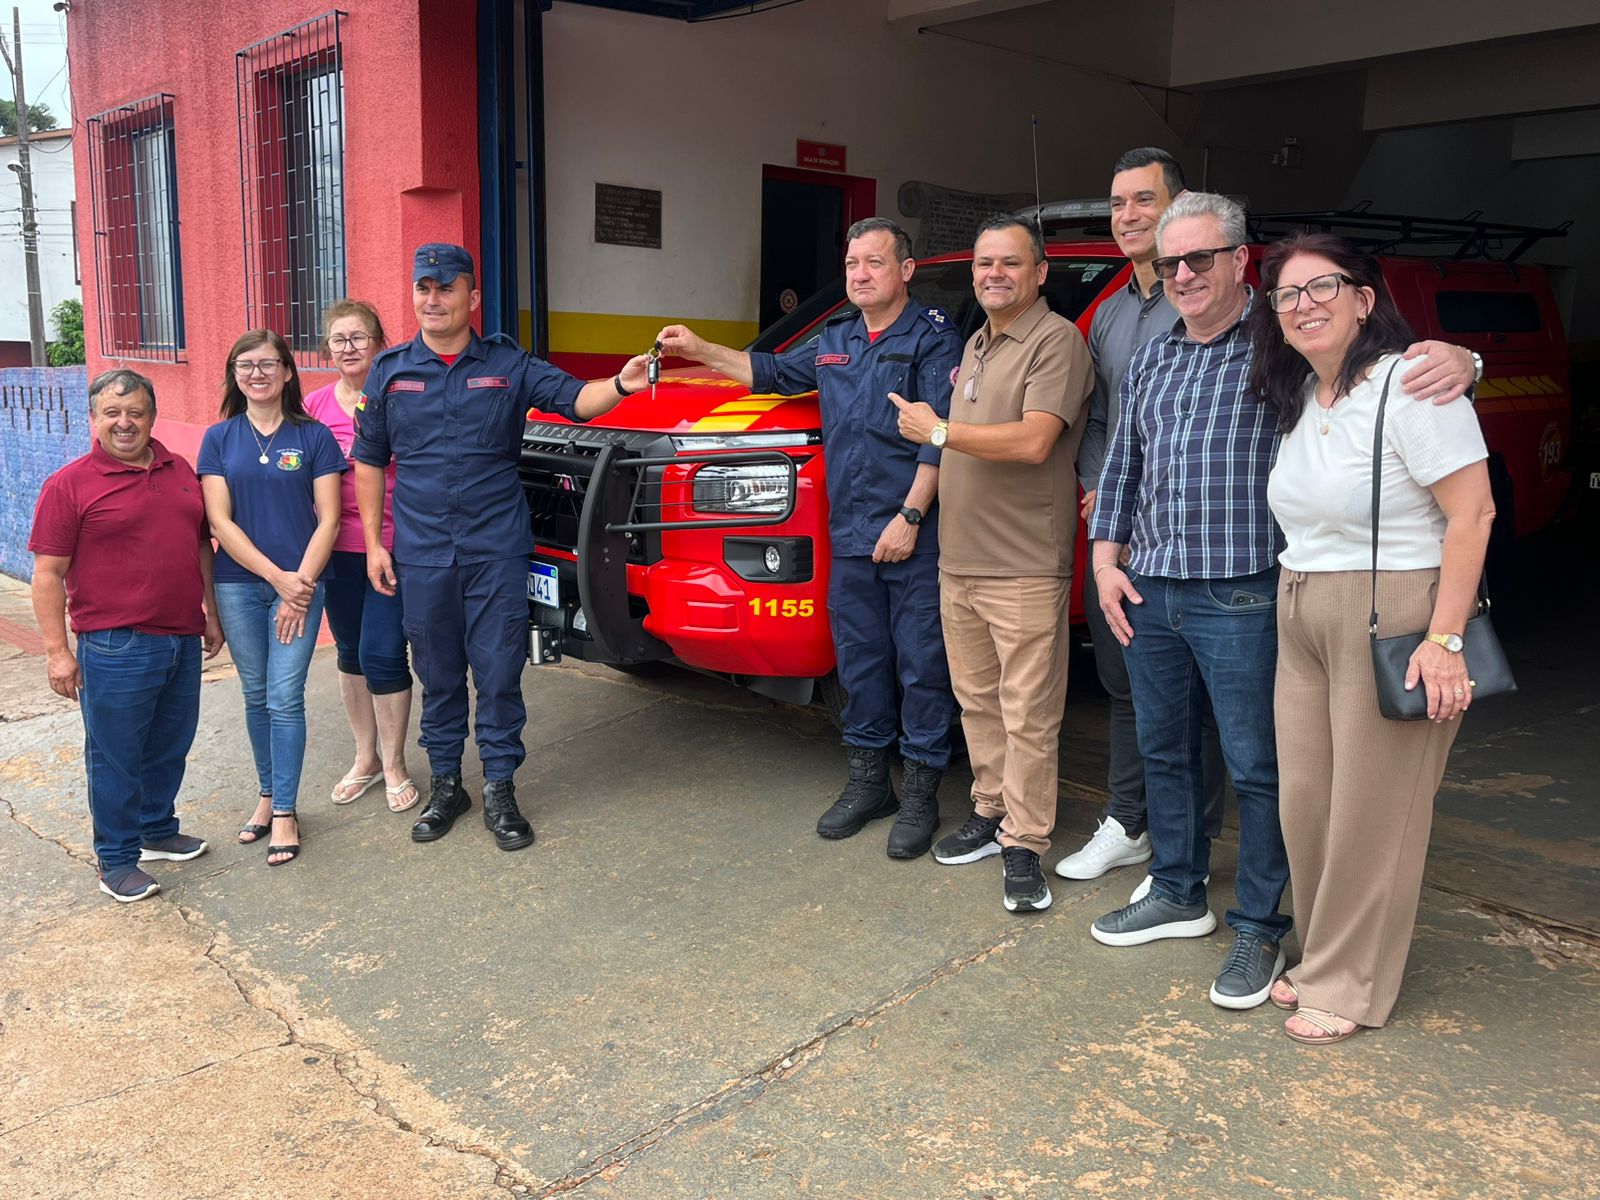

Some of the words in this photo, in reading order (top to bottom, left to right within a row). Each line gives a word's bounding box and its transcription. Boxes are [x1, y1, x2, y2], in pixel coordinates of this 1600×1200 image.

[529, 424, 640, 445] MITSUBISHI
[1543, 440, 1561, 464] 193
[748, 597, 815, 617] 1155
